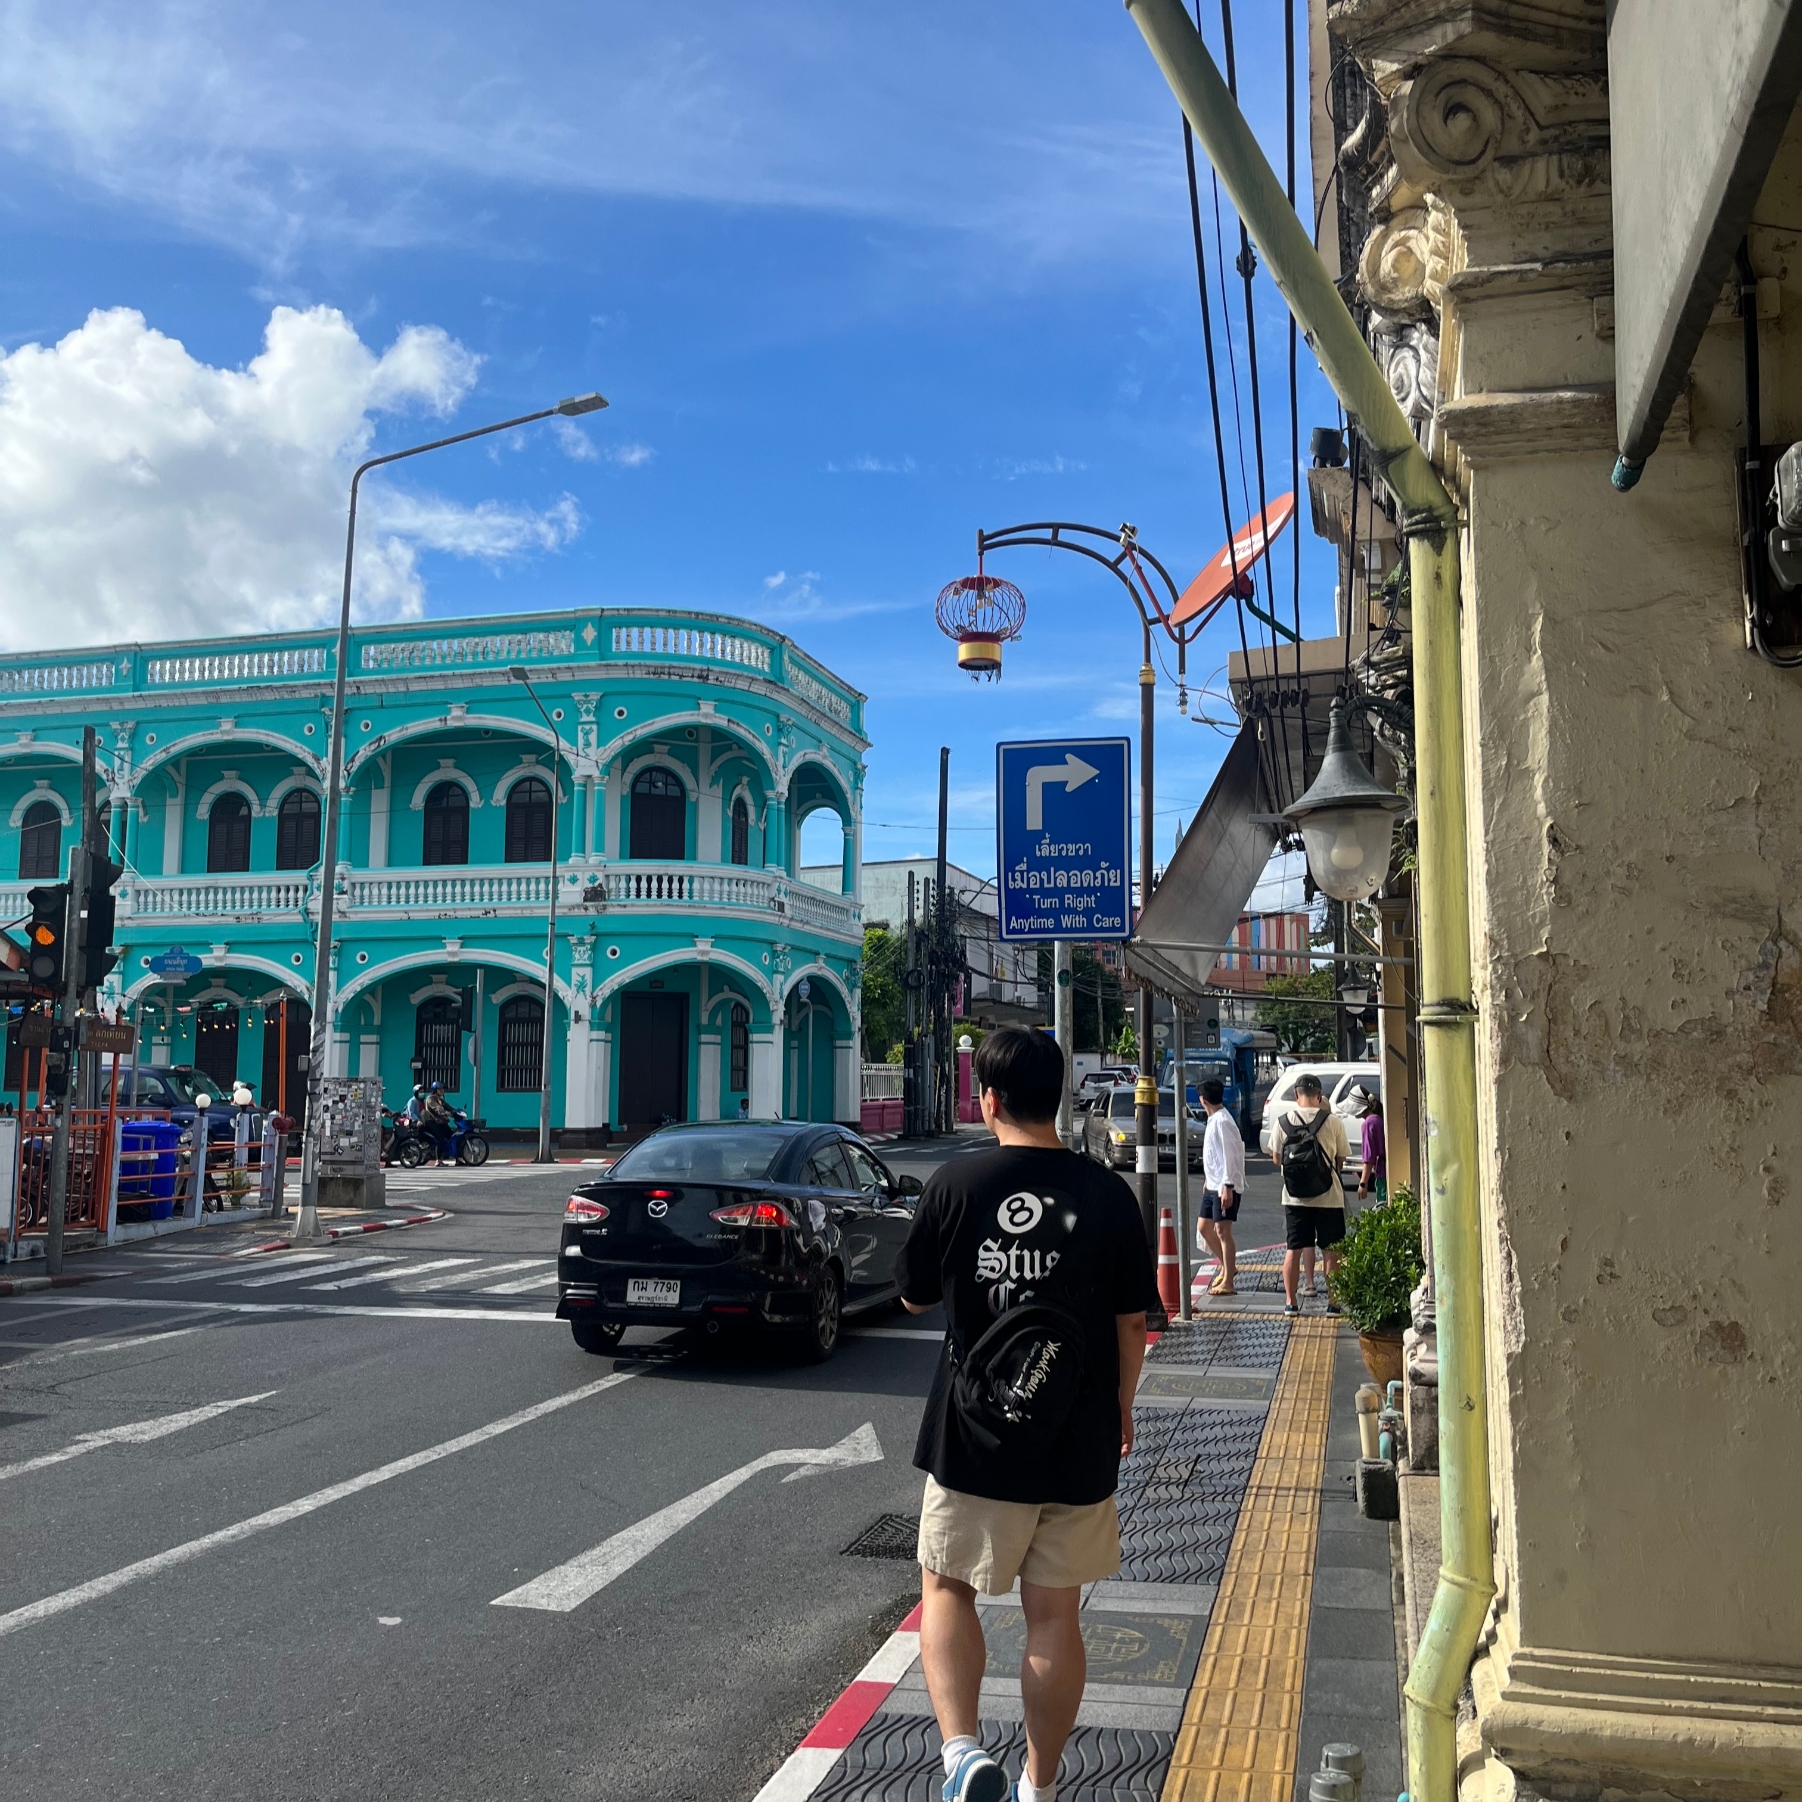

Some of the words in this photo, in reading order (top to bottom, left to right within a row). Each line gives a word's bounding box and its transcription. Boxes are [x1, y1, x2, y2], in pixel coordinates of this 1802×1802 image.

[1035, 832, 1092, 857] เลี้ยวขวา
[1008, 857, 1121, 889] เมื่อปลอดภัย
[1033, 895, 1059, 909] Turn
[1064, 894, 1096, 911] Right
[1009, 915, 1055, 932] Anytime
[1060, 915, 1087, 928] With
[1093, 914, 1121, 928] Care
[1006, 1196, 1034, 1227] 8
[632, 1280, 649, 1292] กม
[653, 1281, 679, 1293] 7790
